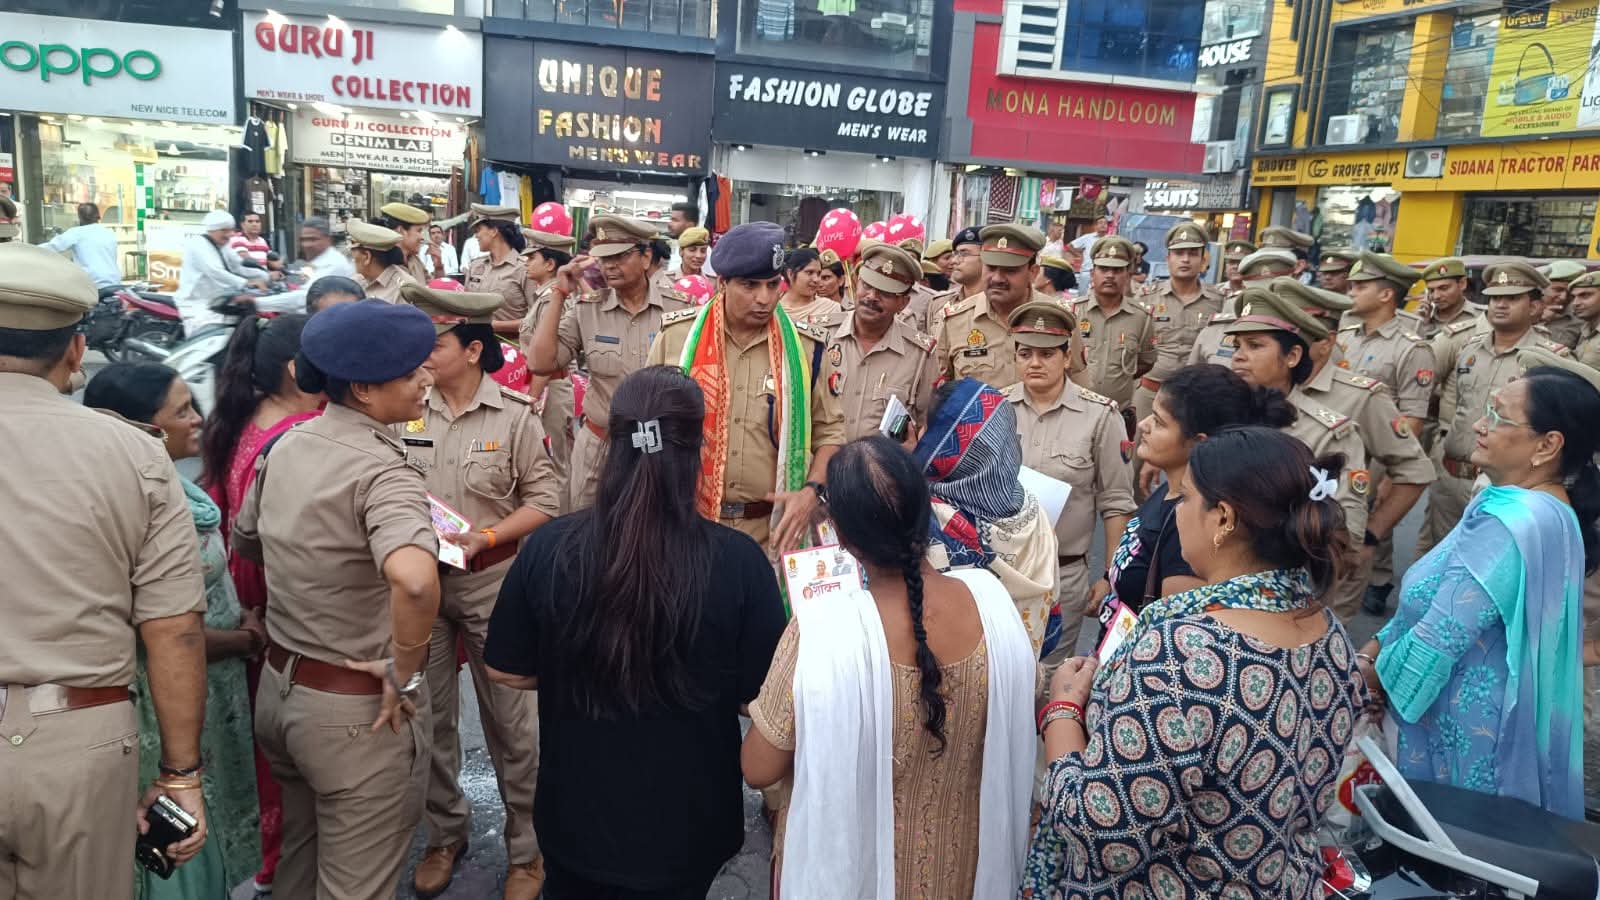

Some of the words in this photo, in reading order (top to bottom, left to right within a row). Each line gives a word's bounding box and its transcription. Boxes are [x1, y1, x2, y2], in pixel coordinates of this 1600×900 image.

[256, 22, 343, 58] GURU
[352, 30, 374, 64] JI
[0, 41, 161, 86] oppo
[538, 58, 663, 102] UNIQUE
[332, 75, 471, 108] COLLECTION
[729, 74, 841, 108] FASHION
[847, 87, 932, 117] GLOBE
[131, 104, 153, 114] NEW
[156, 105, 179, 115] NICE
[181, 107, 227, 118] TELECOM
[987, 88, 1049, 114] MONA
[1058, 95, 1176, 127] HANDLOOM
[312, 118, 349, 129] GURU
[354, 121, 364, 130] JI
[368, 122, 451, 138] COLLECTION
[538, 109, 662, 144] FASHION
[837, 122, 882, 138] MEN'S
[887, 126, 927, 143] WEAR
[332, 135, 390, 150] DENIM
[394, 138, 430, 151] LAB
[356, 153, 389, 161] WEAR
[403, 157, 440, 166] SHOES
[569, 145, 628, 163] MEN'S
[634, 150, 702, 168] WEAR
[1450, 160, 1494, 175] SIDANA
[1500, 156, 1565, 174] TRACTOR
[1332, 163, 1370, 177] GROVER
[1374, 161, 1401, 175] GUYS
[1154, 189, 1200, 207] SUITS
[824, 231, 845, 242] LOVE
